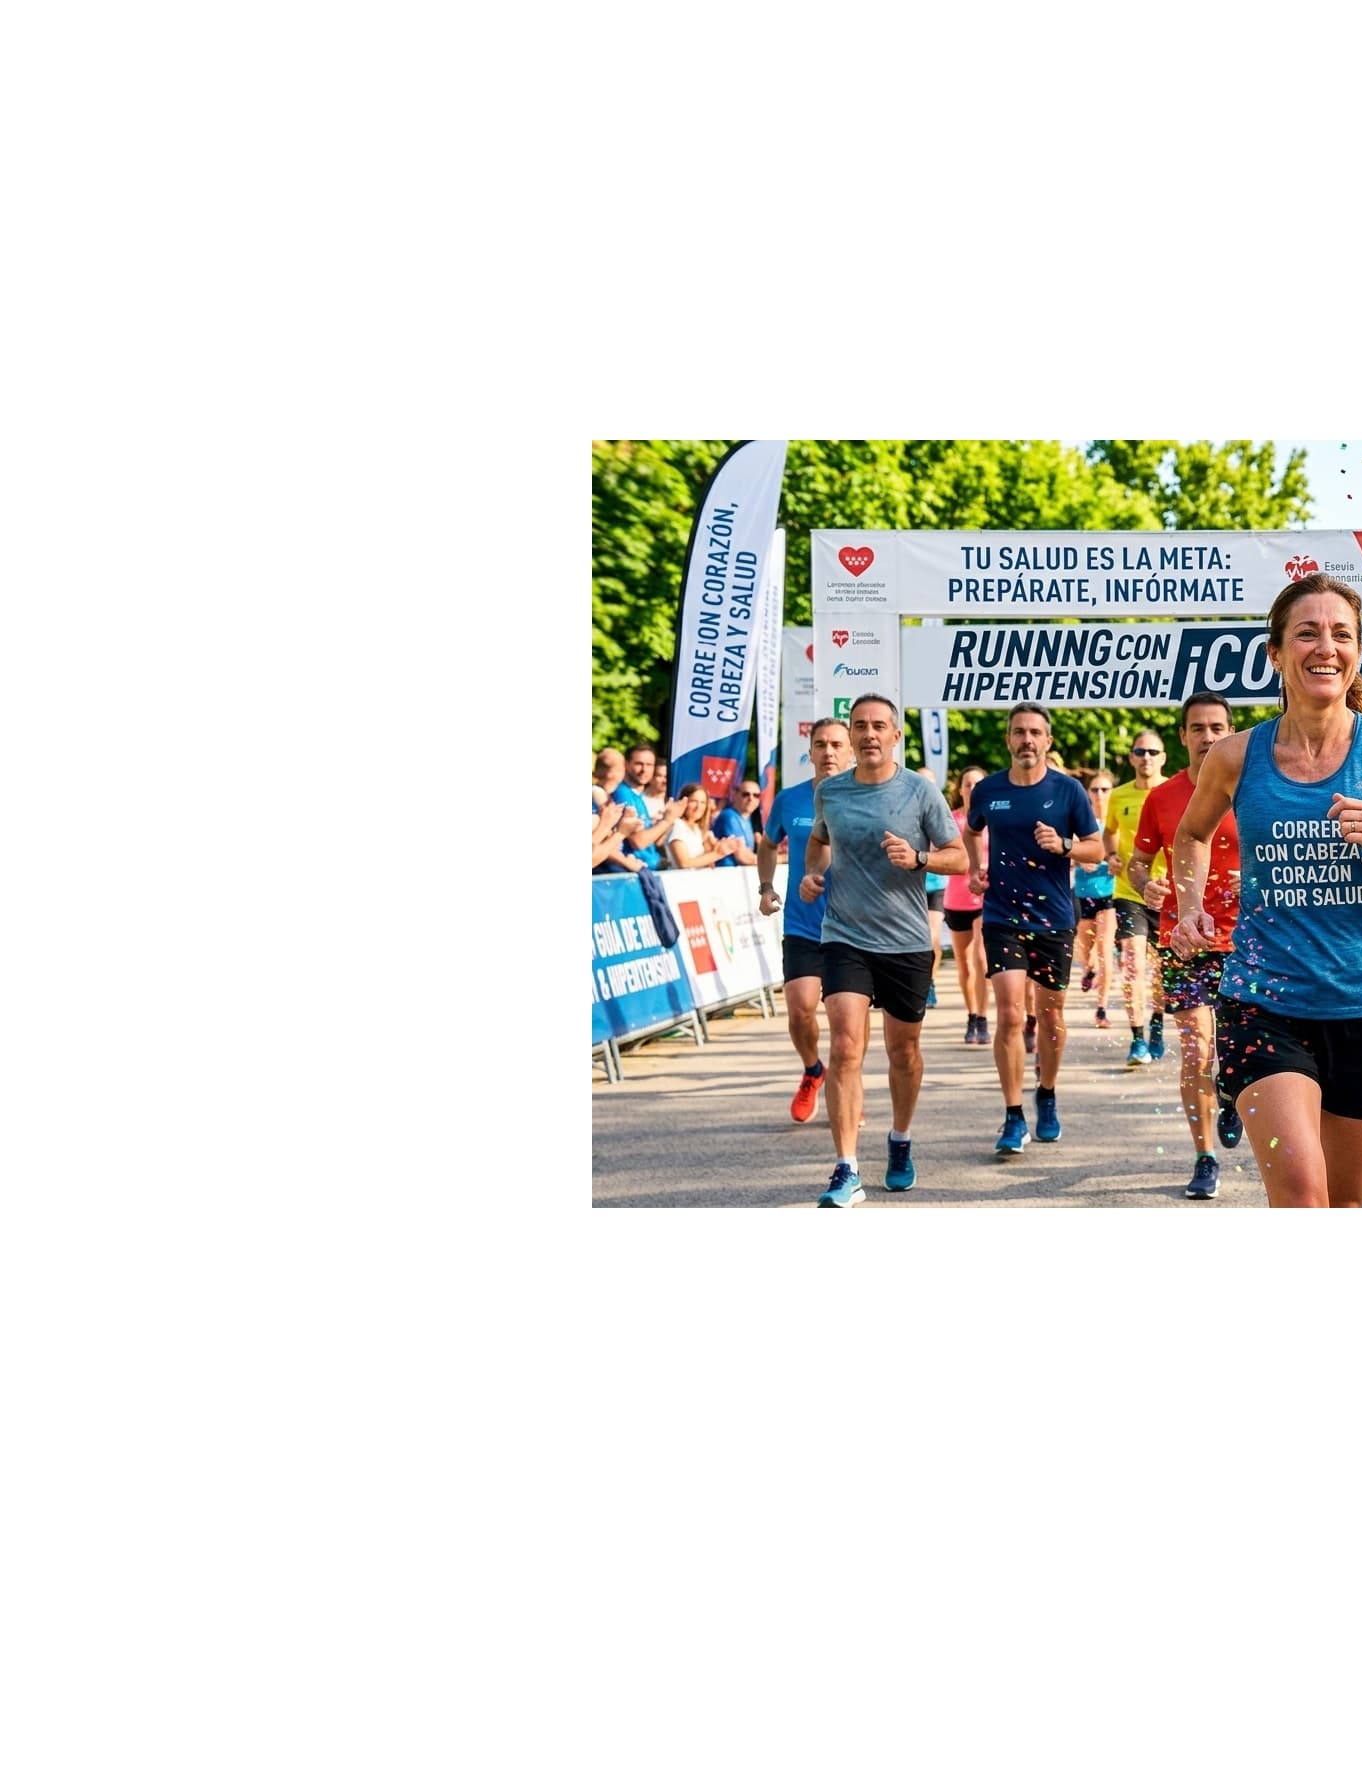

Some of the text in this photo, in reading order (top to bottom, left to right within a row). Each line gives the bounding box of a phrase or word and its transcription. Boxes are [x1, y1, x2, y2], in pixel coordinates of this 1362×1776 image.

[702, 502, 739, 606] CORAZÓN,
[961, 546, 1232, 570] TU SALUD ES LA META:
[948, 573, 1244, 606] PREPÁRATE, INFÓRMATE
[717, 551, 757, 723] CABEZA Y SALUD
[949, 629, 1172, 668] RUNNNG CON
[688, 649, 717, 718] CORRE
[942, 662, 1169, 701] HIPERTENSIÓN:
[1272, 820, 1343, 839] CORRER
[1255, 843, 1288, 862] CON
[1271, 860, 1352, 885] CORAZÓN
[1261, 889, 1271, 907] Y
[1274, 888, 1308, 907] POR
[594, 913, 627, 958] GUÍA
[620, 917, 643, 953] DE
